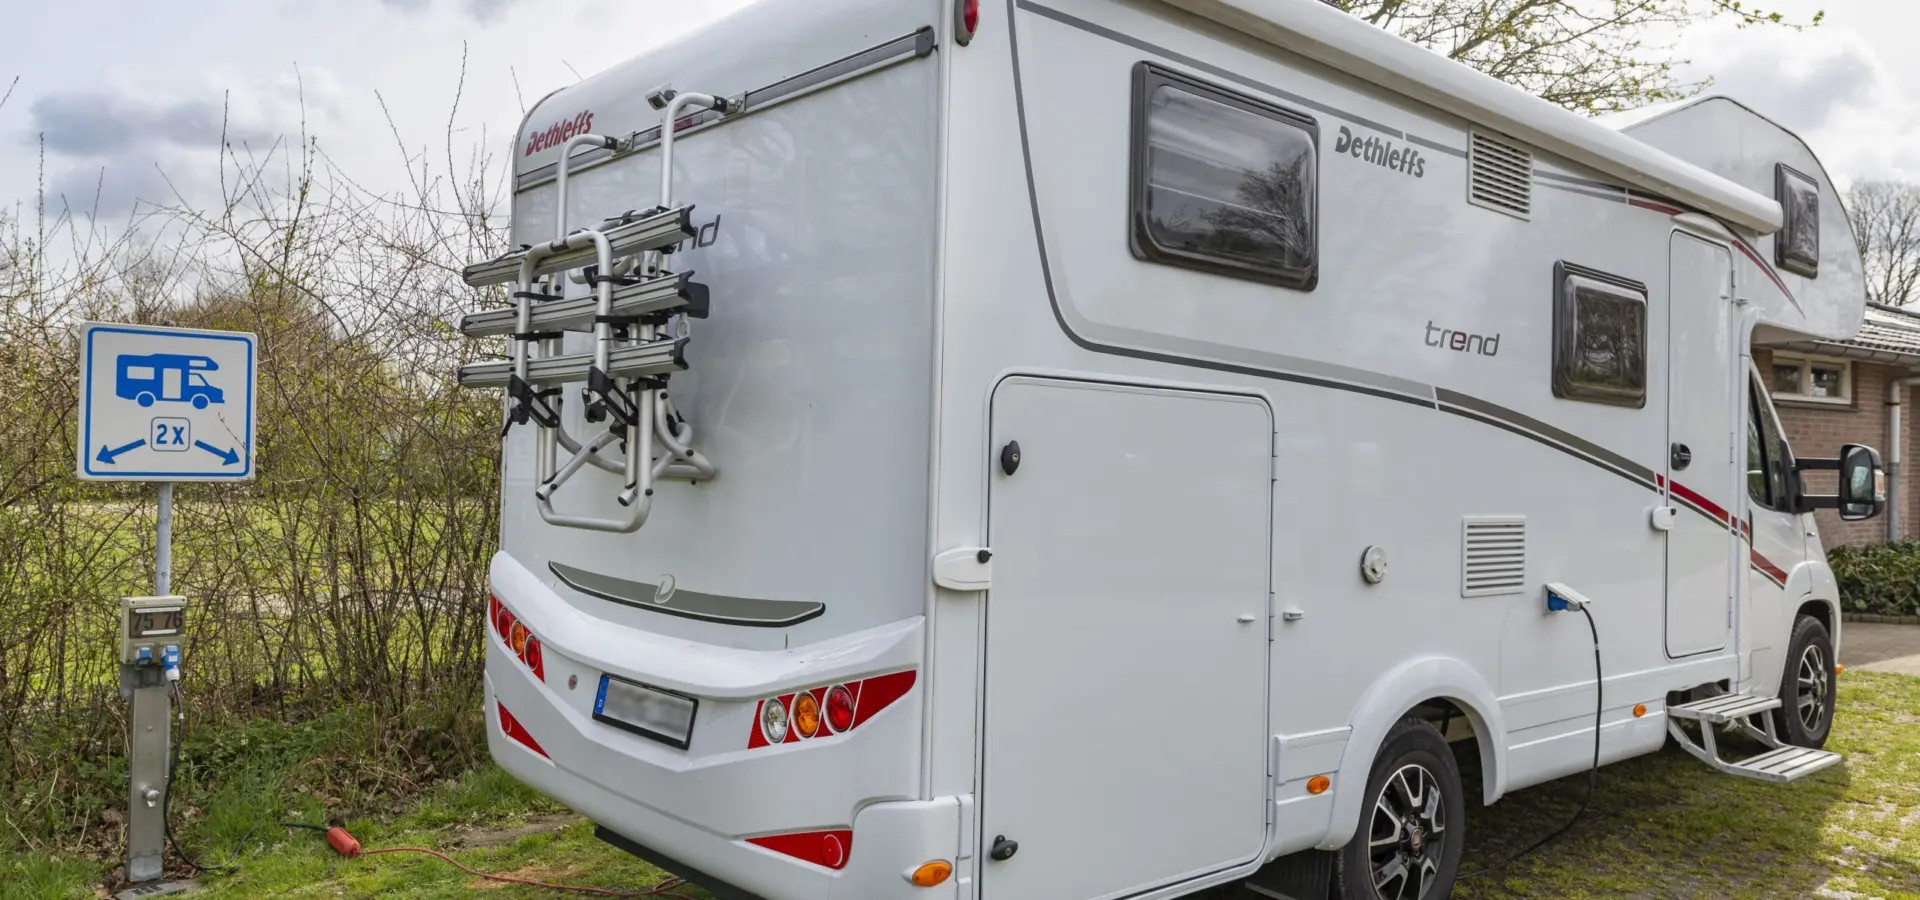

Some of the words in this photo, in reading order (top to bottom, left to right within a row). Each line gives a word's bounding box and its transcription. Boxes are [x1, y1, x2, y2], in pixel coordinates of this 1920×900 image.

[525, 110, 593, 156] Dethleffs
[1335, 125, 1425, 178] Dethleffs
[1425, 320, 1500, 356] trend
[133, 612, 154, 631] 75
[163, 610, 183, 629] 76
